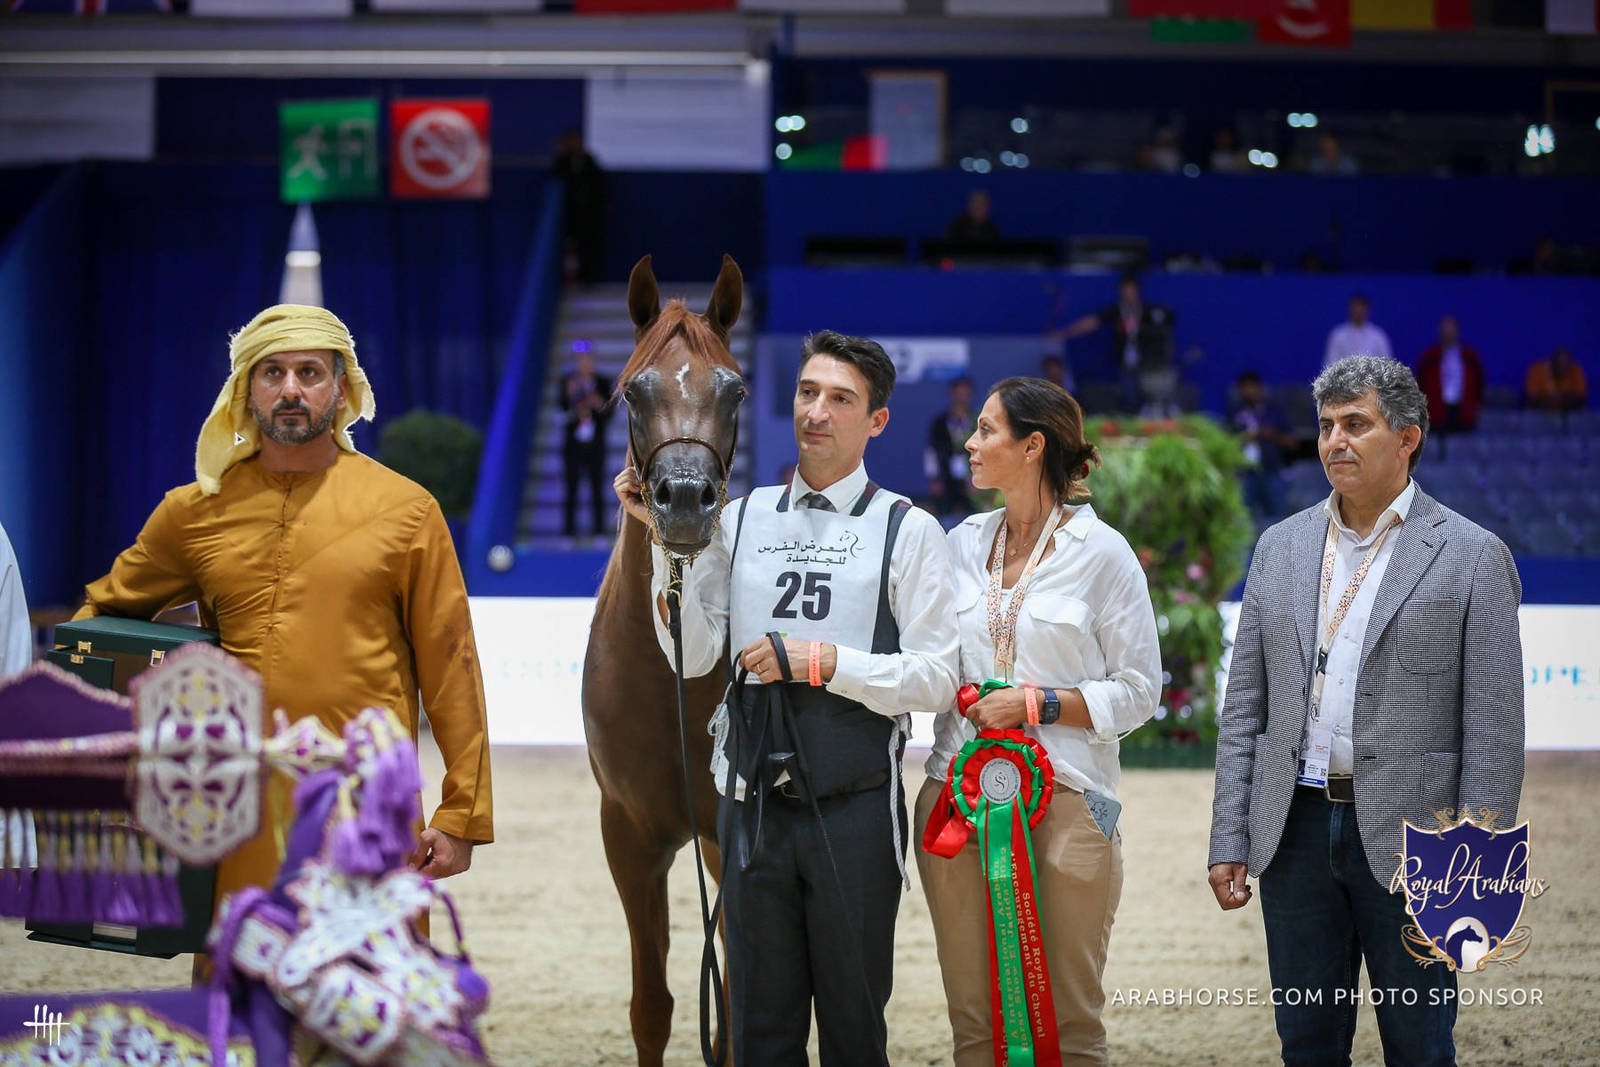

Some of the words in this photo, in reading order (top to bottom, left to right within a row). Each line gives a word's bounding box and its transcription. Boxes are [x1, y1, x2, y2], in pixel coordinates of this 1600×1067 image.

[757, 541, 800, 554] الفرس
[786, 553, 847, 567] للجديدة
[801, 540, 848, 553] معرض
[771, 571, 832, 621] 25
[1022, 892, 1038, 942] Société
[1032, 947, 1046, 992] Royale
[1000, 923, 1015, 1023] International
[1027, 971, 1037, 989] du
[1031, 992, 1046, 1038] Cheval
